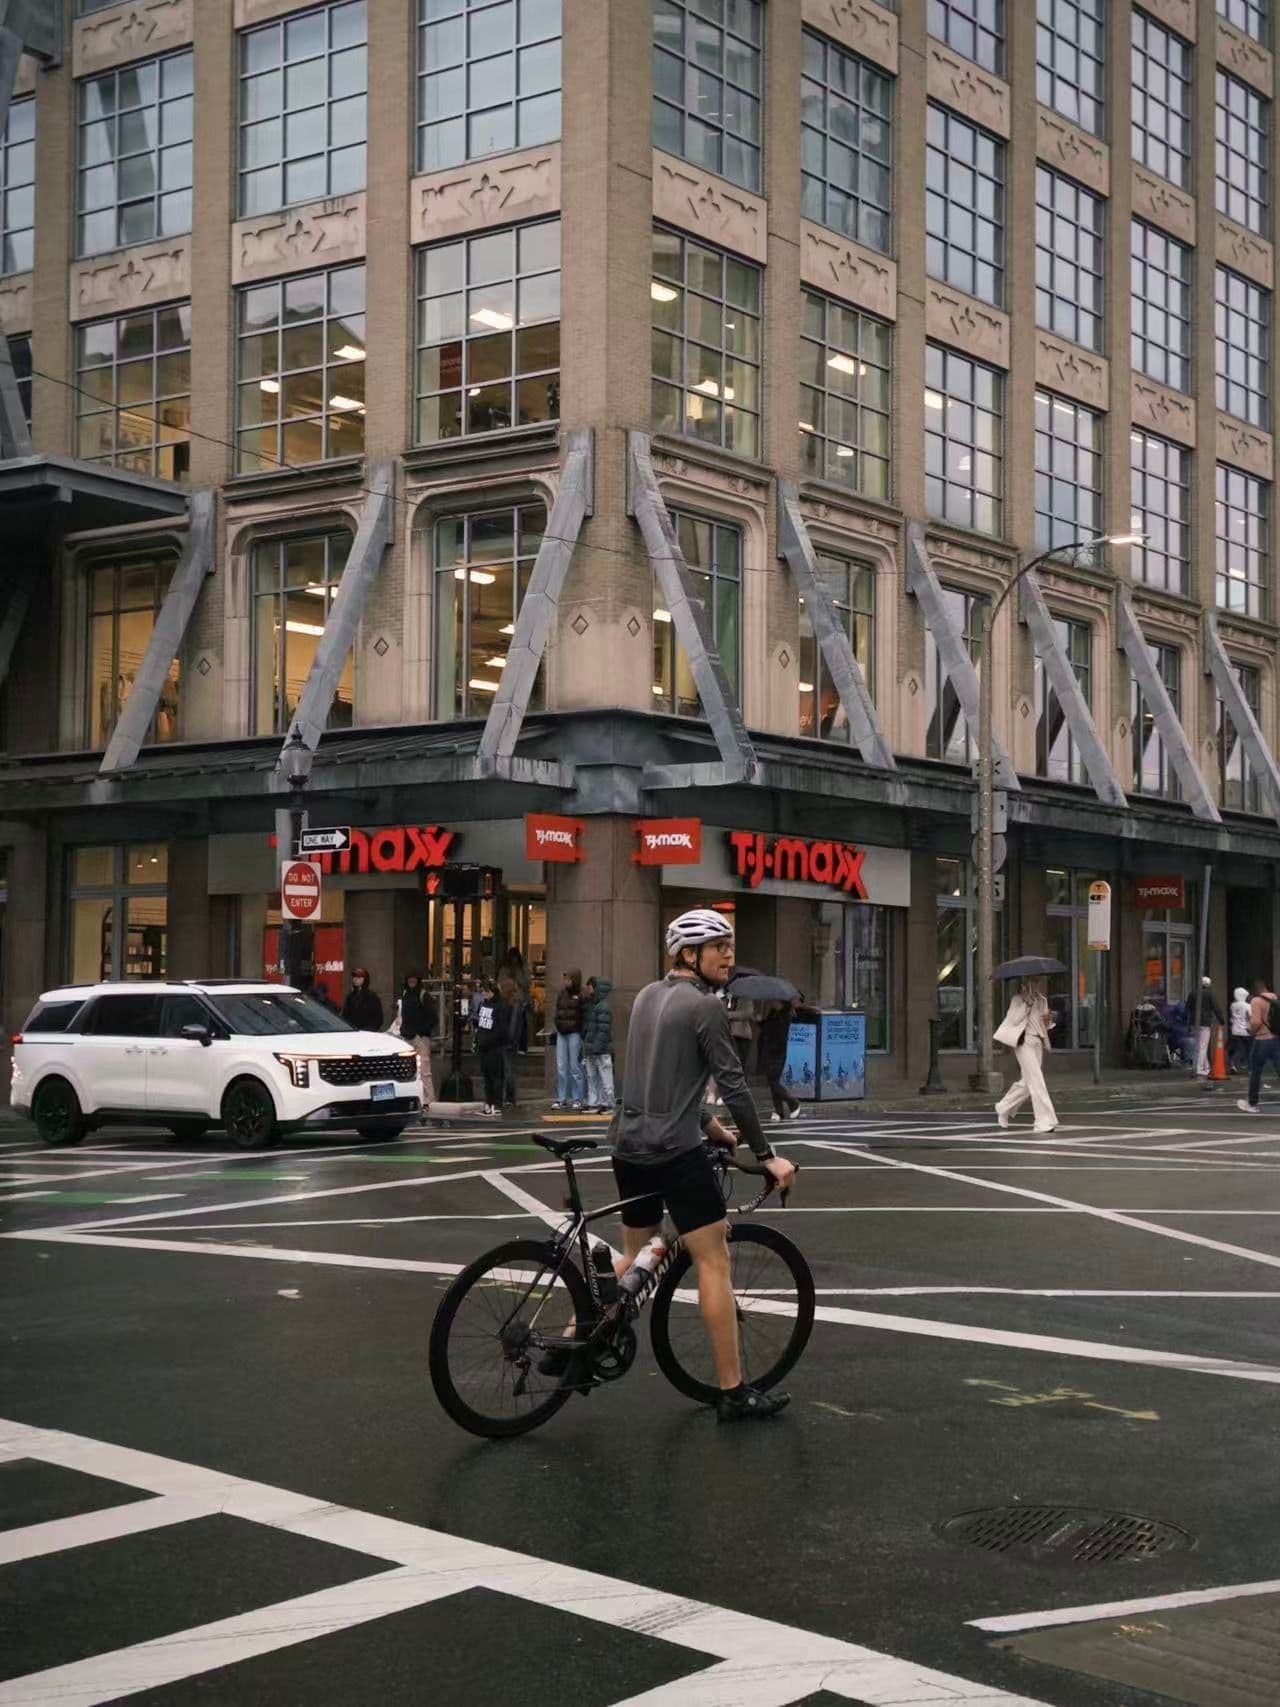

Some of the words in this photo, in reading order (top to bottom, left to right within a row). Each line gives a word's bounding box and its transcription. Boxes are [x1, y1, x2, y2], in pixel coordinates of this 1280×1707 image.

[304, 837, 319, 845] ONE
[288, 873, 298, 882] DO
[301, 873, 315, 882] NOT
[290, 898, 313, 908] ENTER
